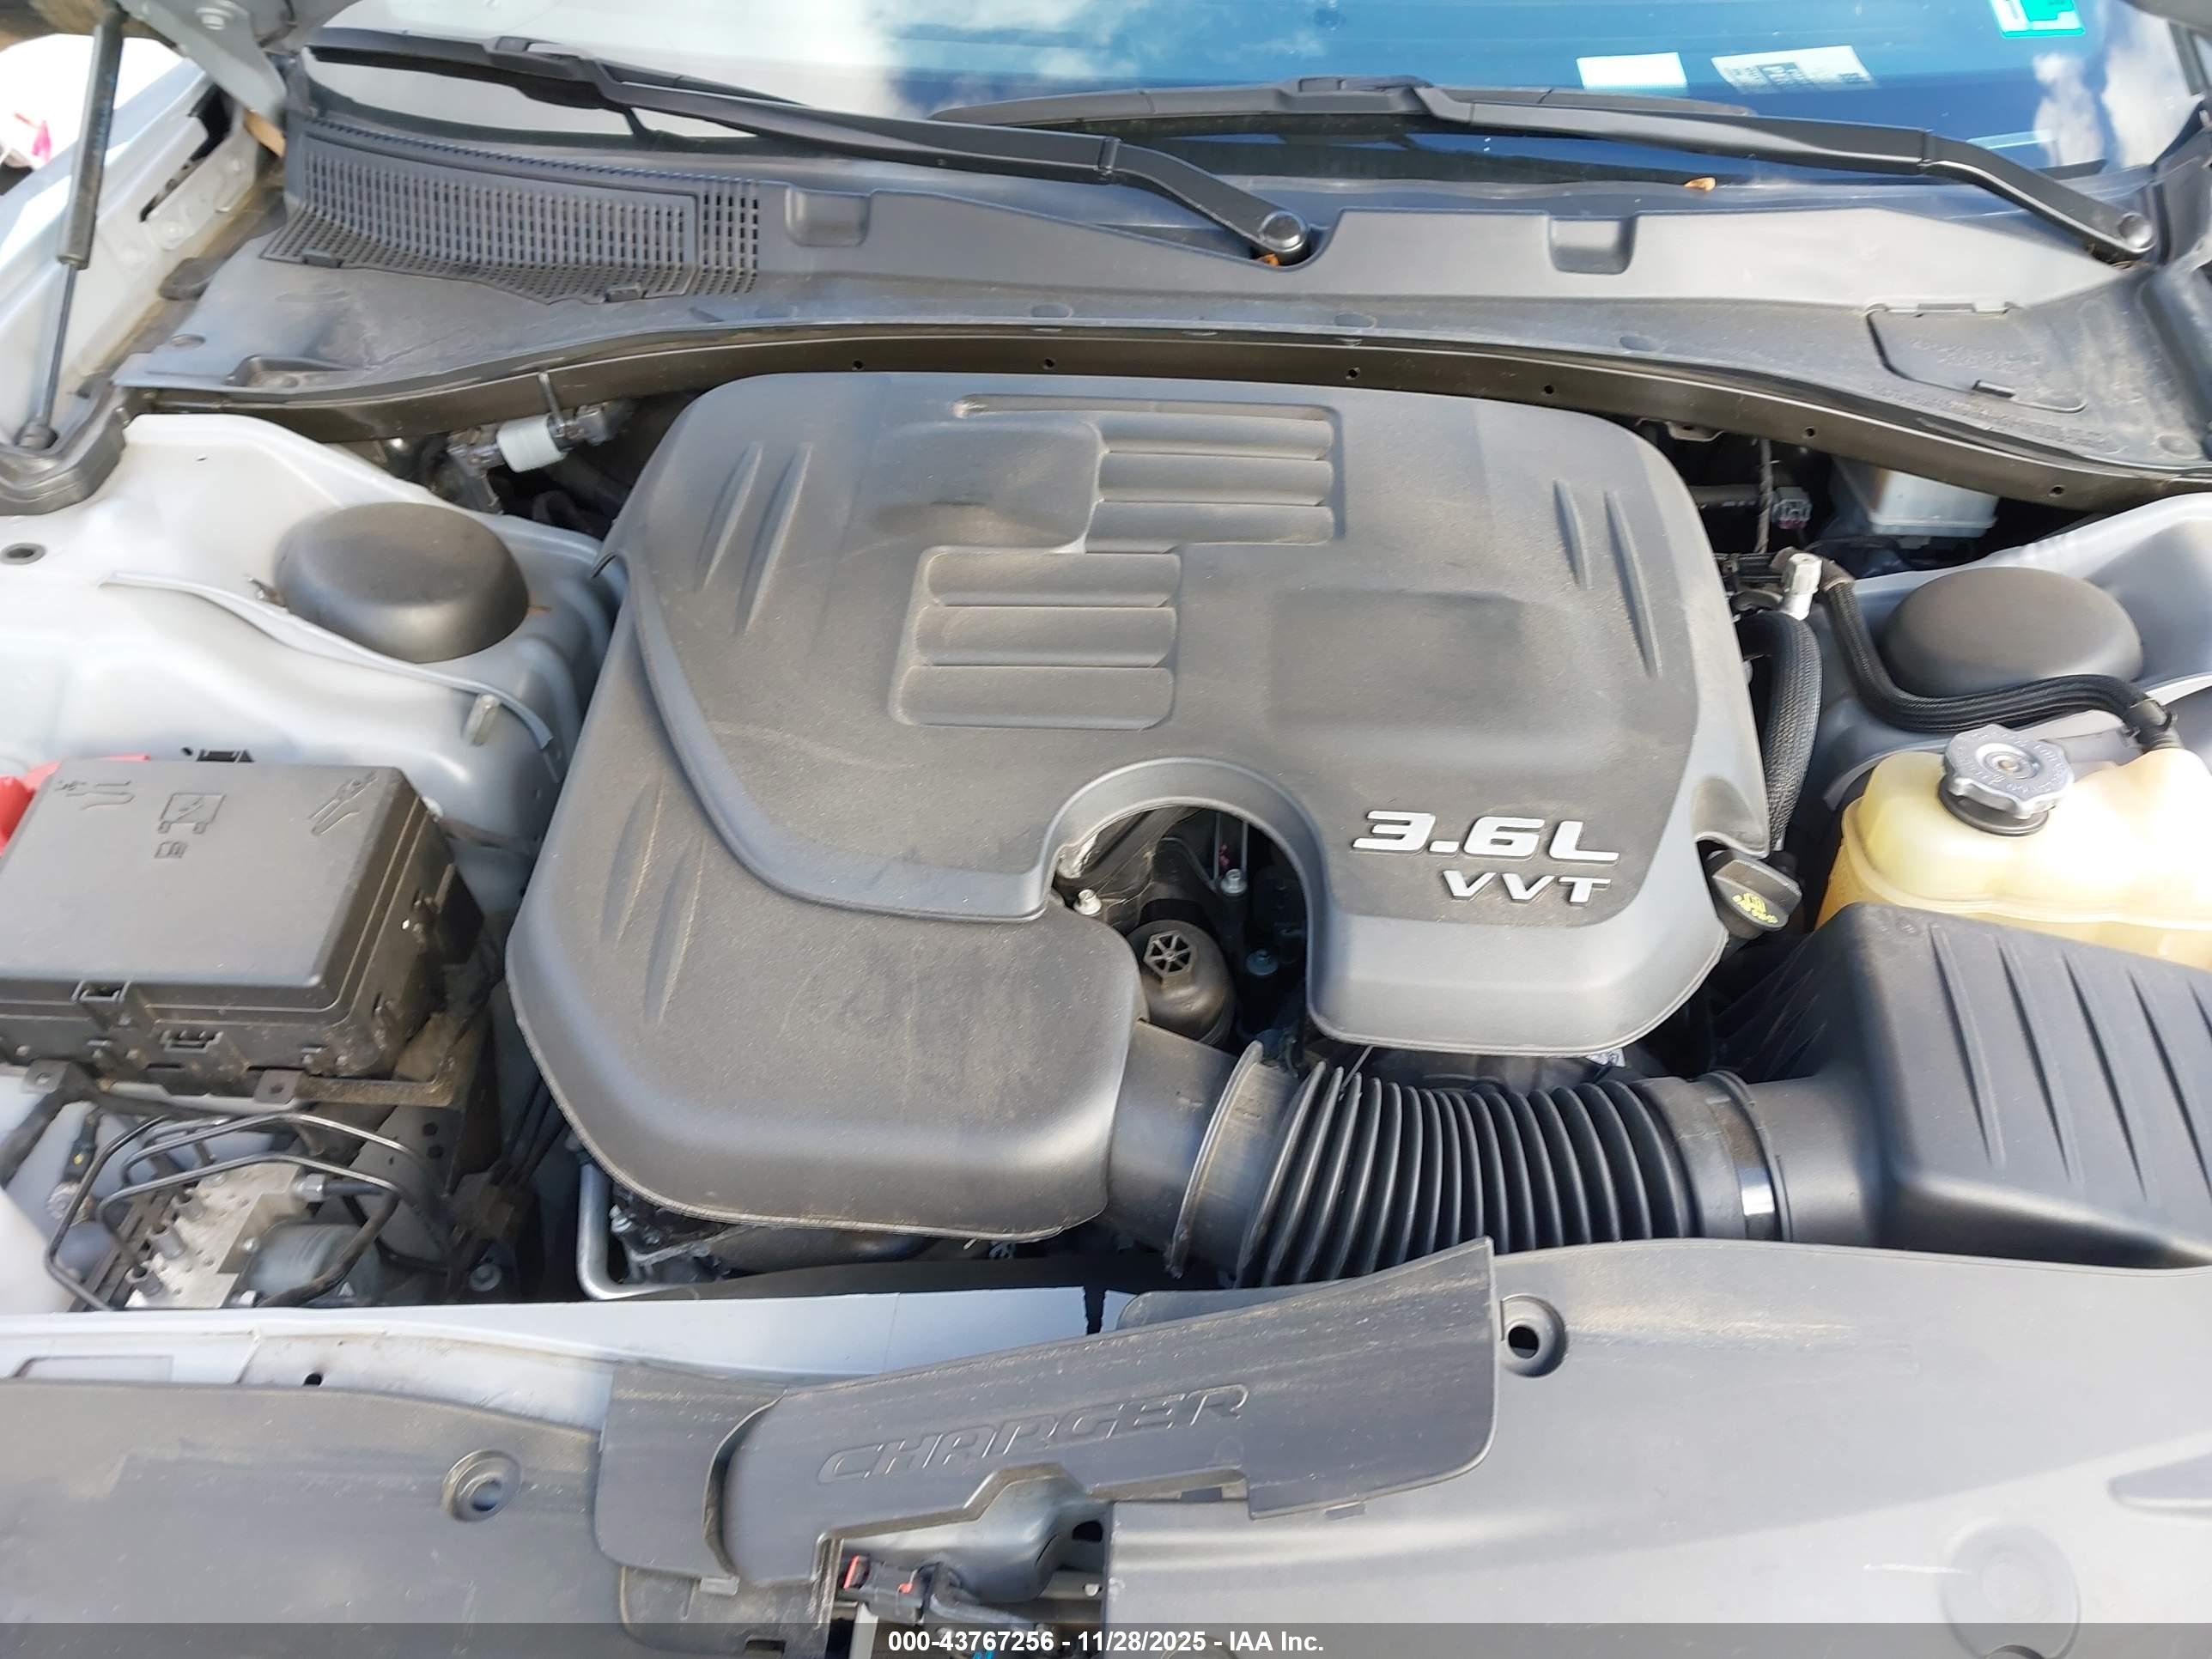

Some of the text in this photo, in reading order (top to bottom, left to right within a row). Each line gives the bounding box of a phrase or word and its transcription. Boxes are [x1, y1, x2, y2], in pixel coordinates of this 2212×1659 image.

[1352, 810, 1620, 864] 3.6L
[1441, 870, 1612, 906] VVT
[817, 1383, 1249, 1484] CHARGER
